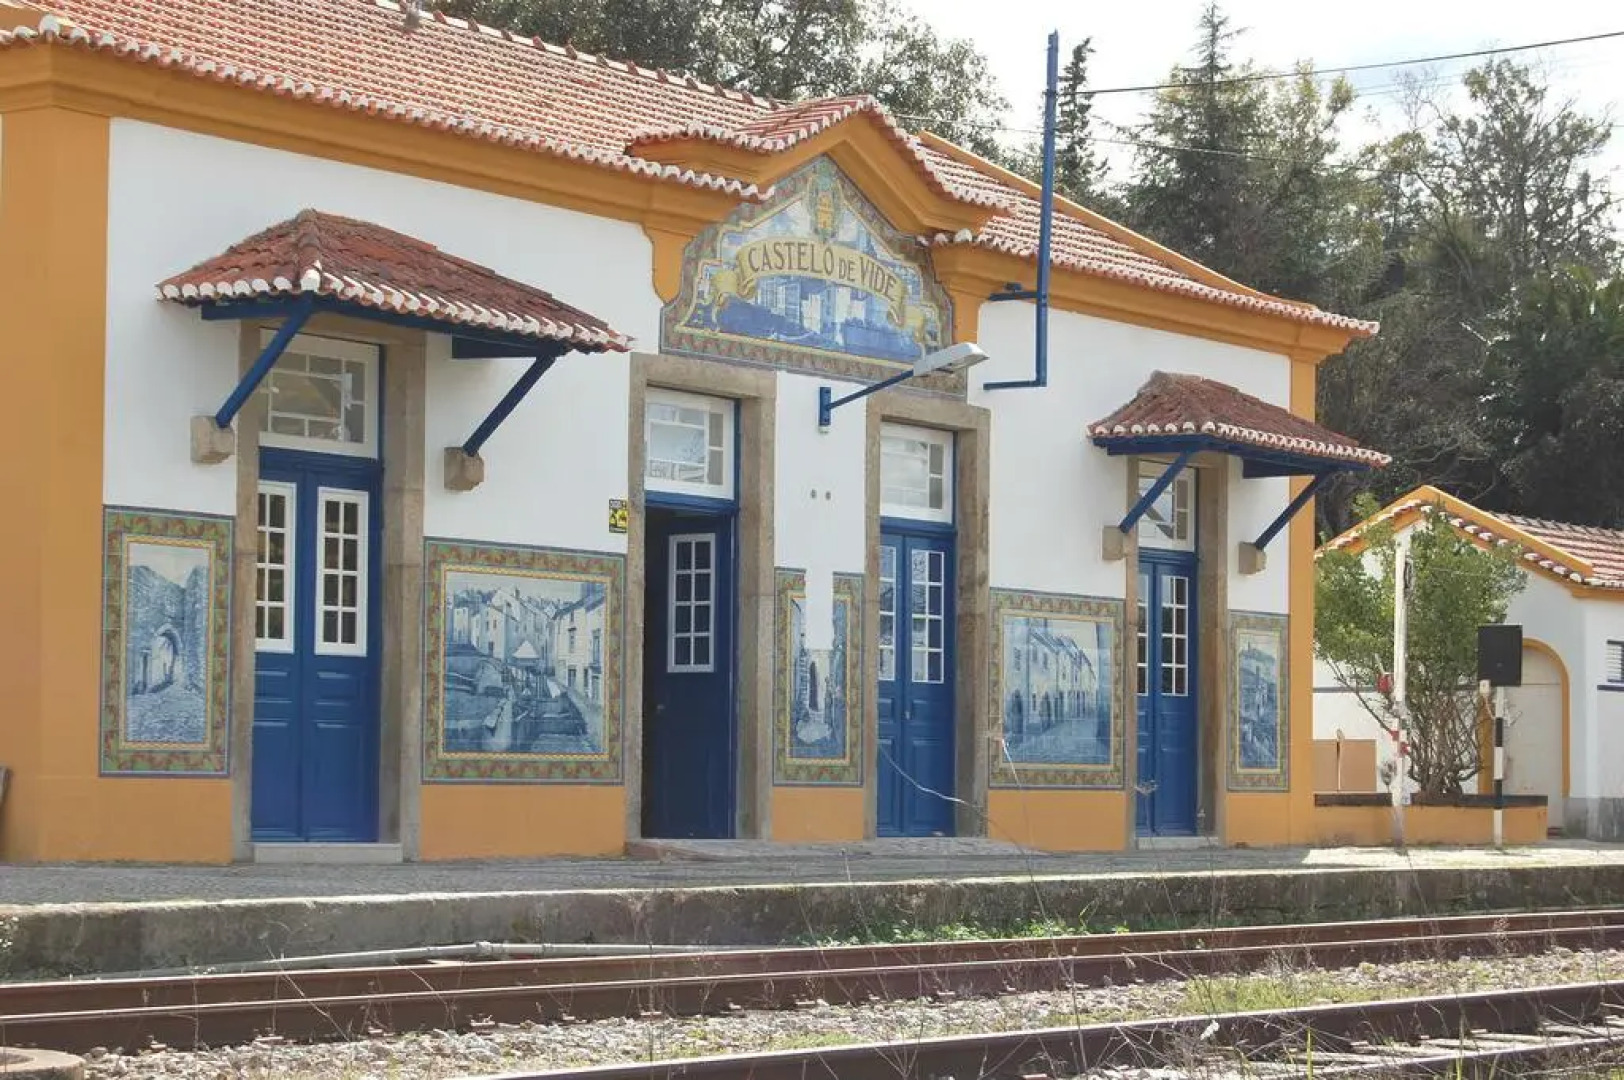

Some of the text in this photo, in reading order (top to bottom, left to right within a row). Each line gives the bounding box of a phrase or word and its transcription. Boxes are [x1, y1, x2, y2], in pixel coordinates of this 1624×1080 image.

[748, 241, 898, 297] CASTELO DE VIDE
